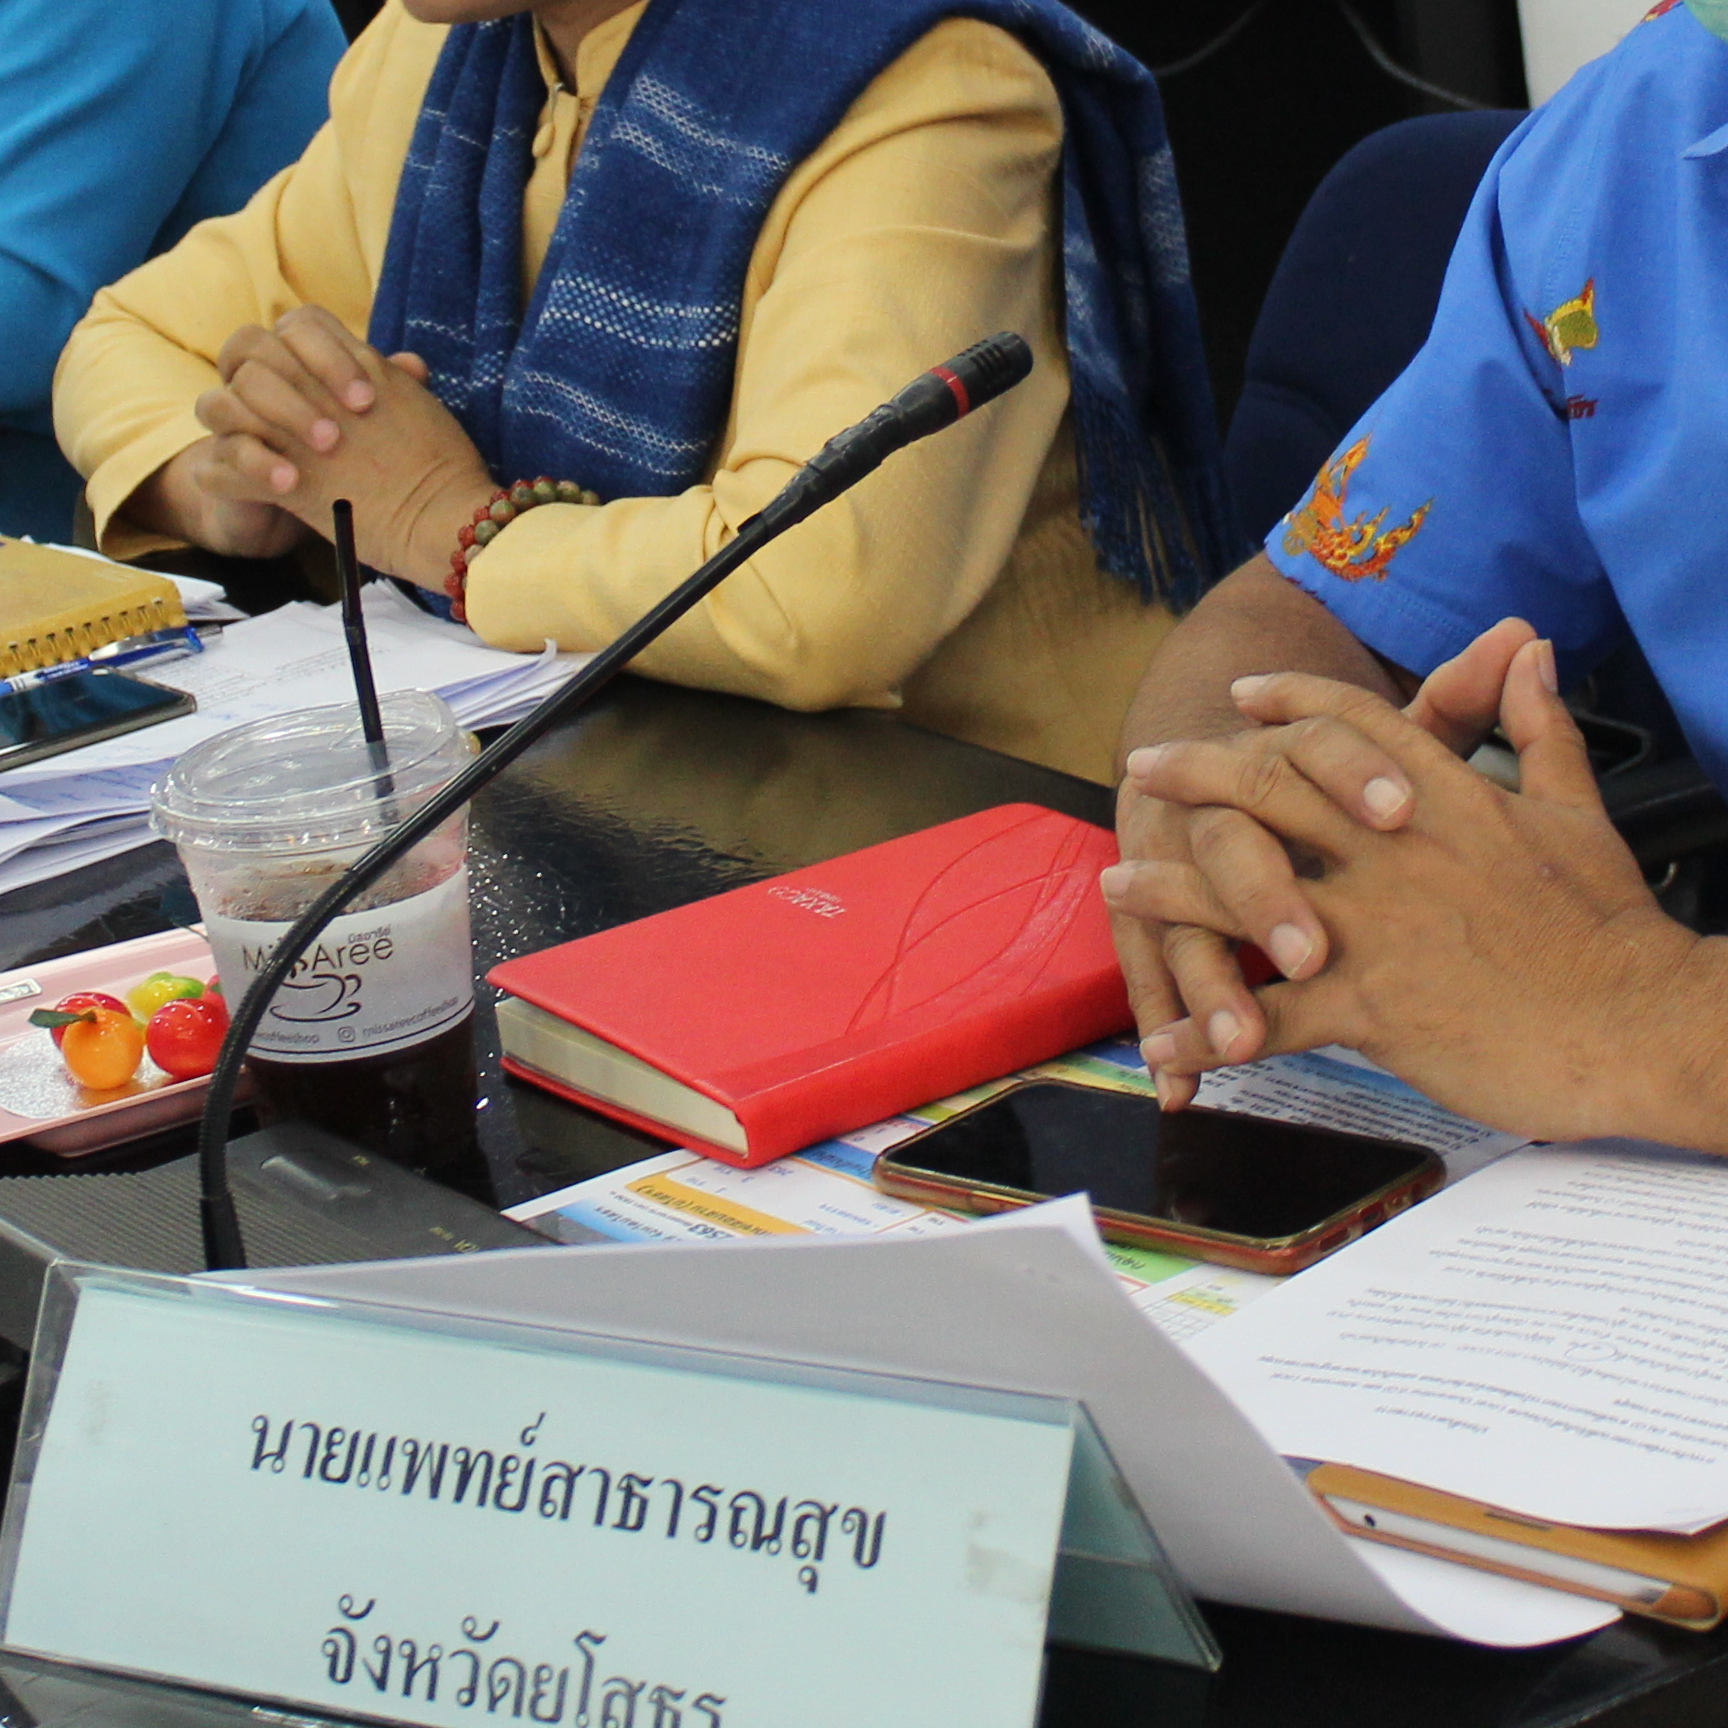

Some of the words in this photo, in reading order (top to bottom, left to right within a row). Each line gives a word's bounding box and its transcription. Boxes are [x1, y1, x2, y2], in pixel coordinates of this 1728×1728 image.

[252, 1411, 885, 1594] นายแพทย์สาธารณสุข
